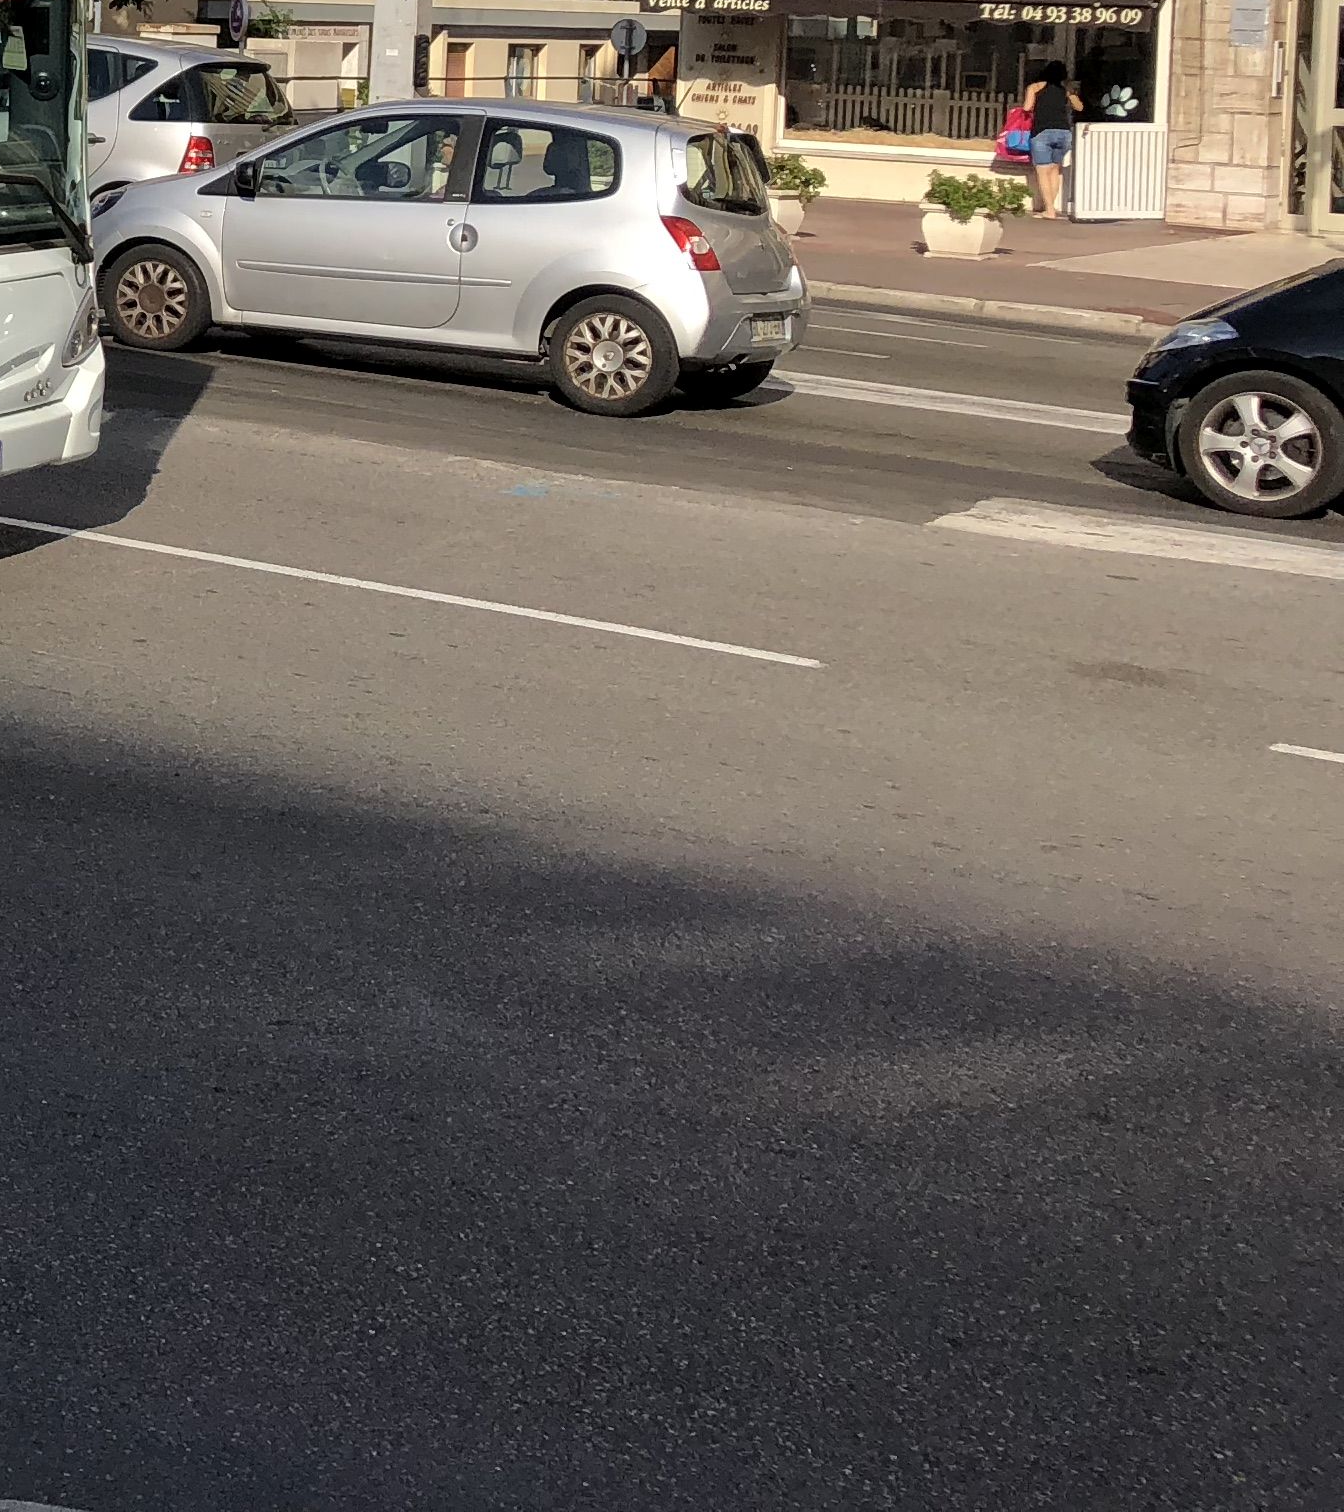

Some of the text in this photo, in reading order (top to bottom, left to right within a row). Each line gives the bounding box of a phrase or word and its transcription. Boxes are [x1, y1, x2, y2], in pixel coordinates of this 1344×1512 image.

[1021, 5, 1044, 21] 04
[1044, 6, 1068, 24] 93
[1068, 6, 1092, 24] 38
[1093, 7, 1117, 24] 96
[1120, 8, 1142, 25] 09
[732, 95, 757, 106] CHATS
